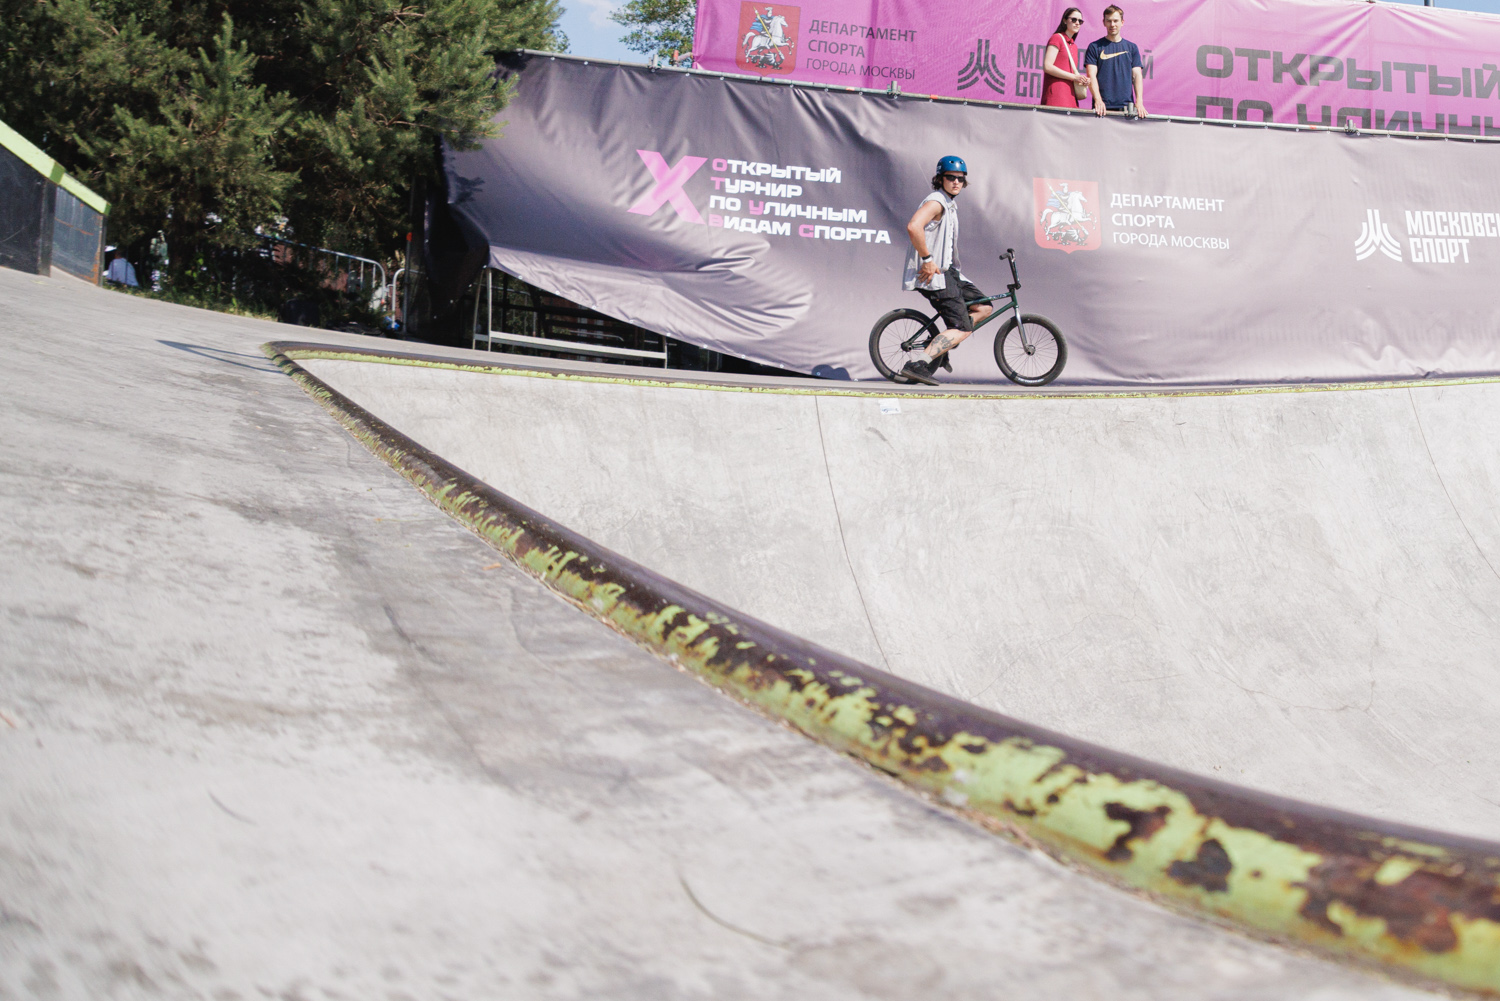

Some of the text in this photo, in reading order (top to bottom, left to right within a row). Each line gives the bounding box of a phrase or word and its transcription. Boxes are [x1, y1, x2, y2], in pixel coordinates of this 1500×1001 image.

[809, 19, 917, 42] ДЕПАРТАМЕНТ
[808, 40, 865, 58] СПОРТА
[806, 58, 915, 80] ГОРОДА МОСКВЫ
[712, 158, 841, 183] ОТКРЫТЫЙ
[710, 177, 802, 198] ТУРНИР
[709, 195, 867, 223] ПО УЛИЧНЫМ
[1110, 193, 1225, 212] ДЕПАРТАМЕНТ
[708, 214, 891, 244] ВИДАМ СПОРТА
[1111, 213, 1175, 229] СПОРТА
[1113, 231, 1230, 250] ГОРОДА МОСКВЫ
[1409, 237, 1470, 264] СПОРТ
